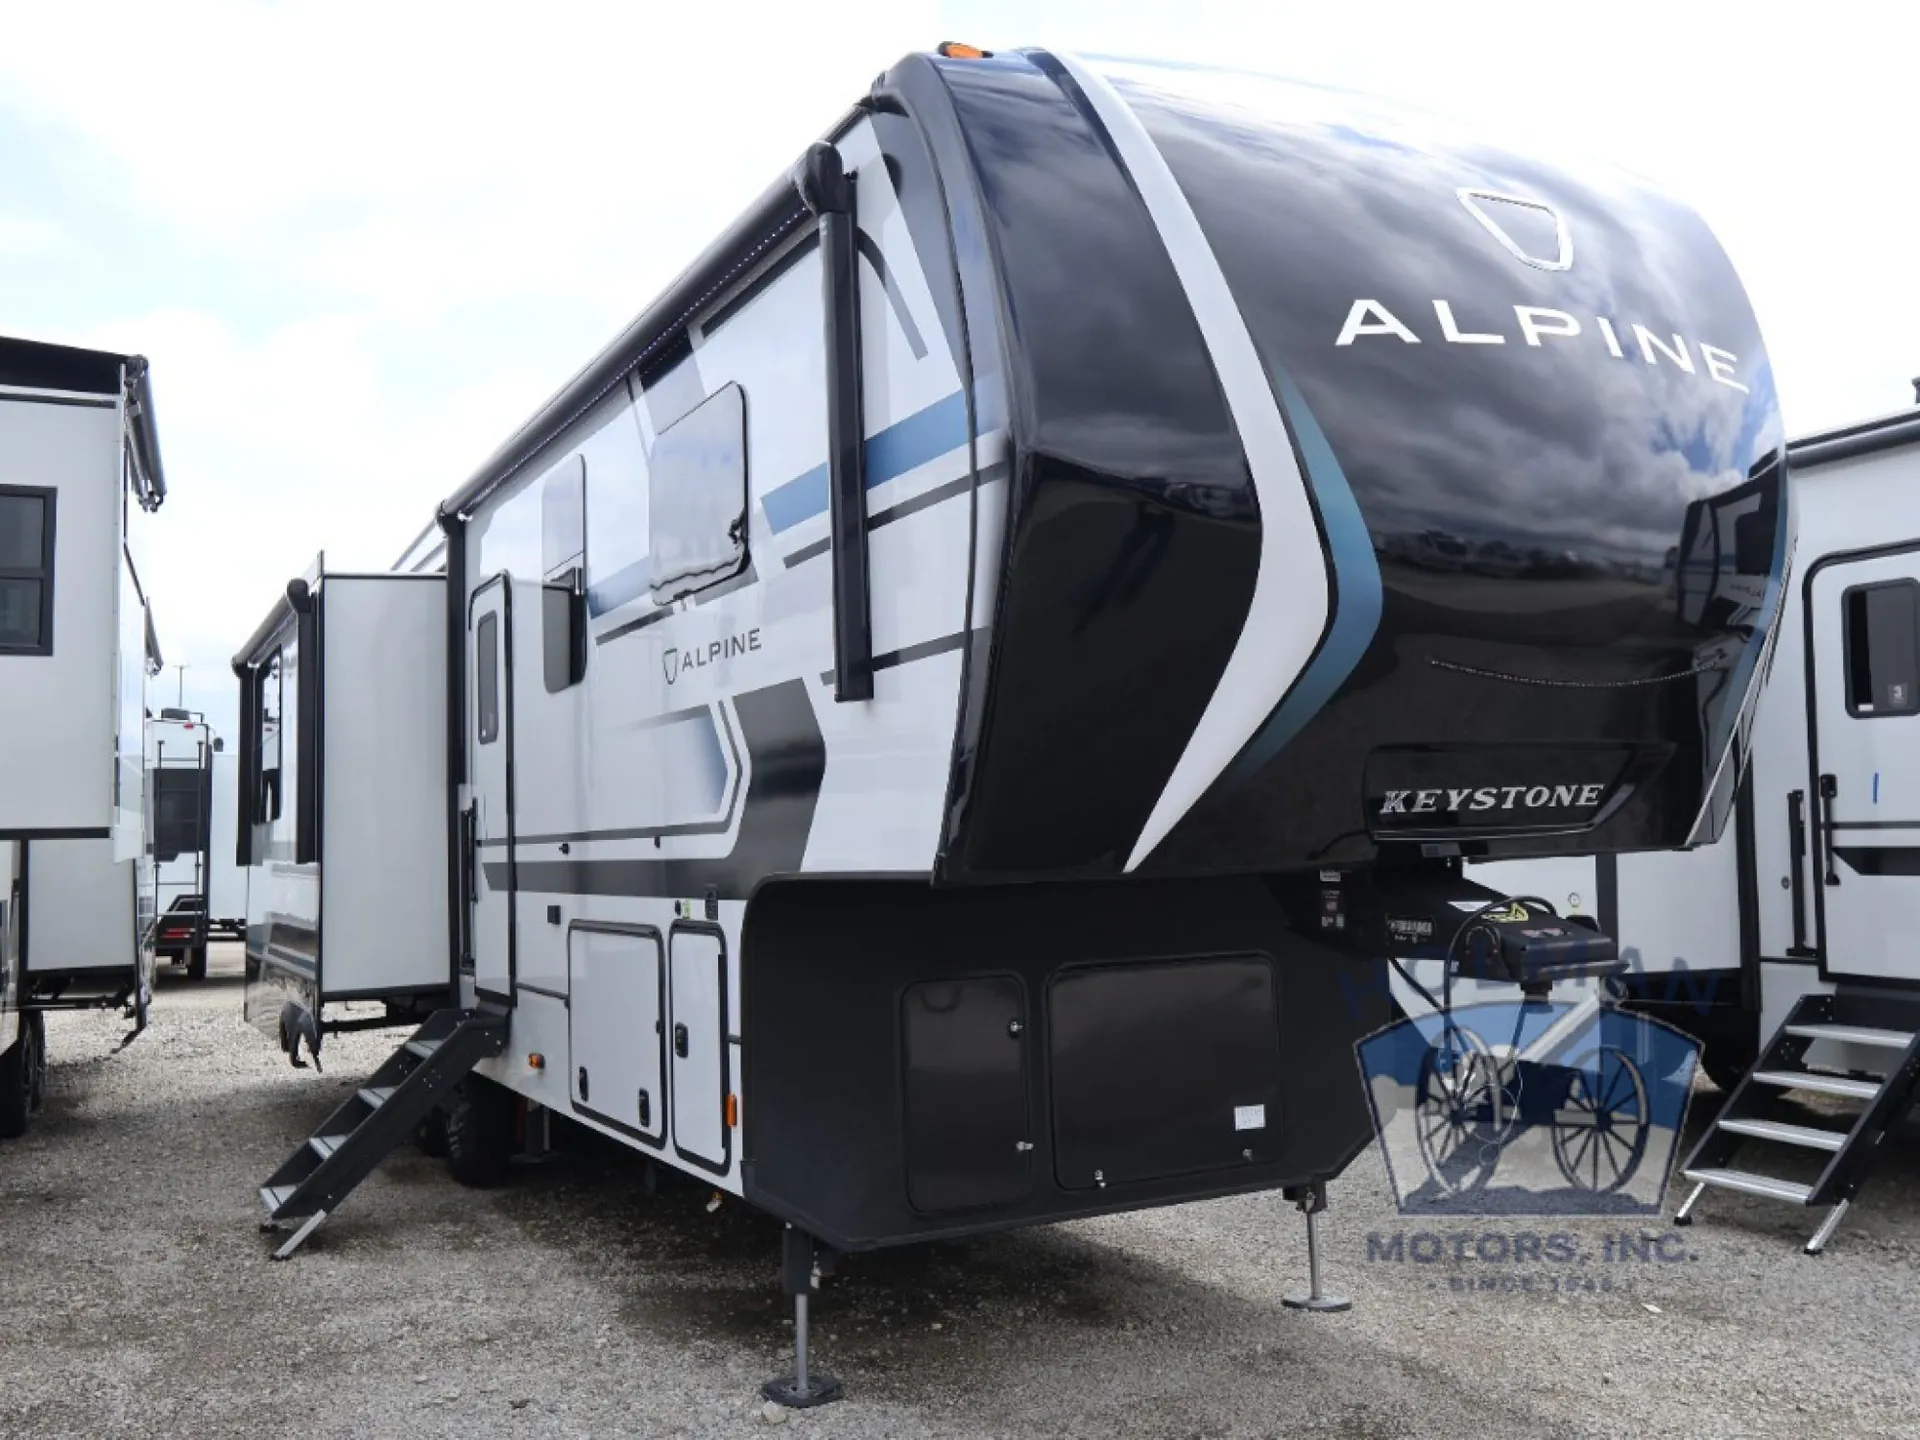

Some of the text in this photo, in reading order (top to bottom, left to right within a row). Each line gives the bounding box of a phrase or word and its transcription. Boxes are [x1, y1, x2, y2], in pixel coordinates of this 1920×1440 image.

[1335, 298, 1750, 394] ALPINE
[681, 627, 762, 672] ALPINE
[1379, 783, 1605, 815] KEYSTONE
